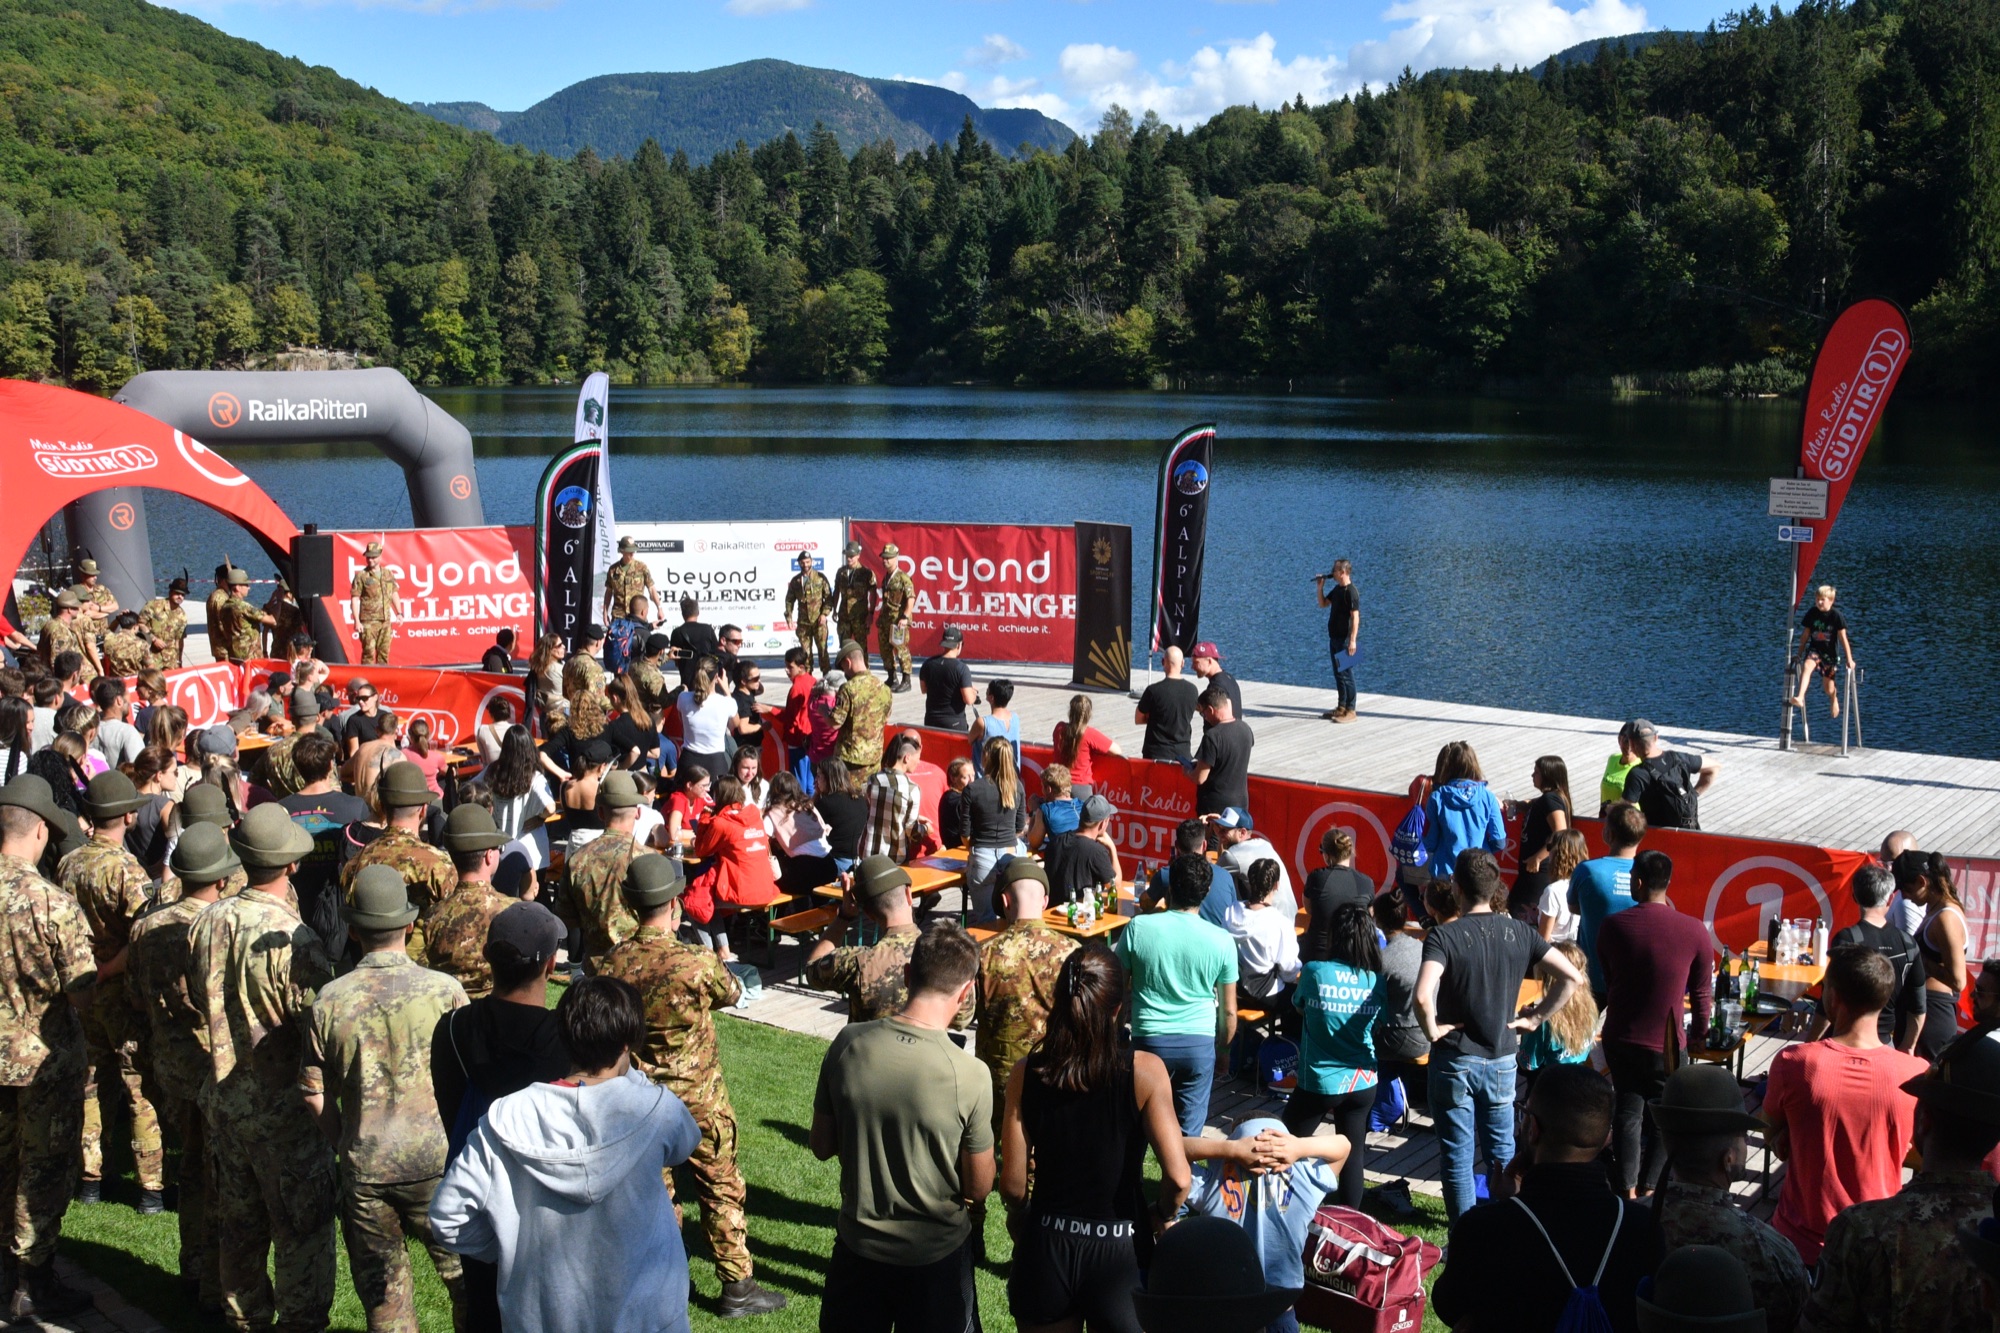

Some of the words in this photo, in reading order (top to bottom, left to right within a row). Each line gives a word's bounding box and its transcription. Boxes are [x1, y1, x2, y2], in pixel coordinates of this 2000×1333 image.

[248, 398, 368, 422] RaikaRitten
[1805, 426, 1829, 463] Mein
[1820, 381, 1848, 422] Radio
[29, 438, 60, 451] Mein
[58, 440, 94, 451] Radio
[711, 540, 766, 552] RaikaRitten
[667, 566, 757, 590] beyond
[1174, 526, 1190, 637] ALPINI
[563, 565, 579, 655] ALPI
[1140, 785, 1191, 813] Radio
[1335, 970, 1359, 984] We
[1318, 983, 1374, 1002] move
[1308, 998, 1381, 1015] mountains
[1274, 1054, 1298, 1066] beyon
